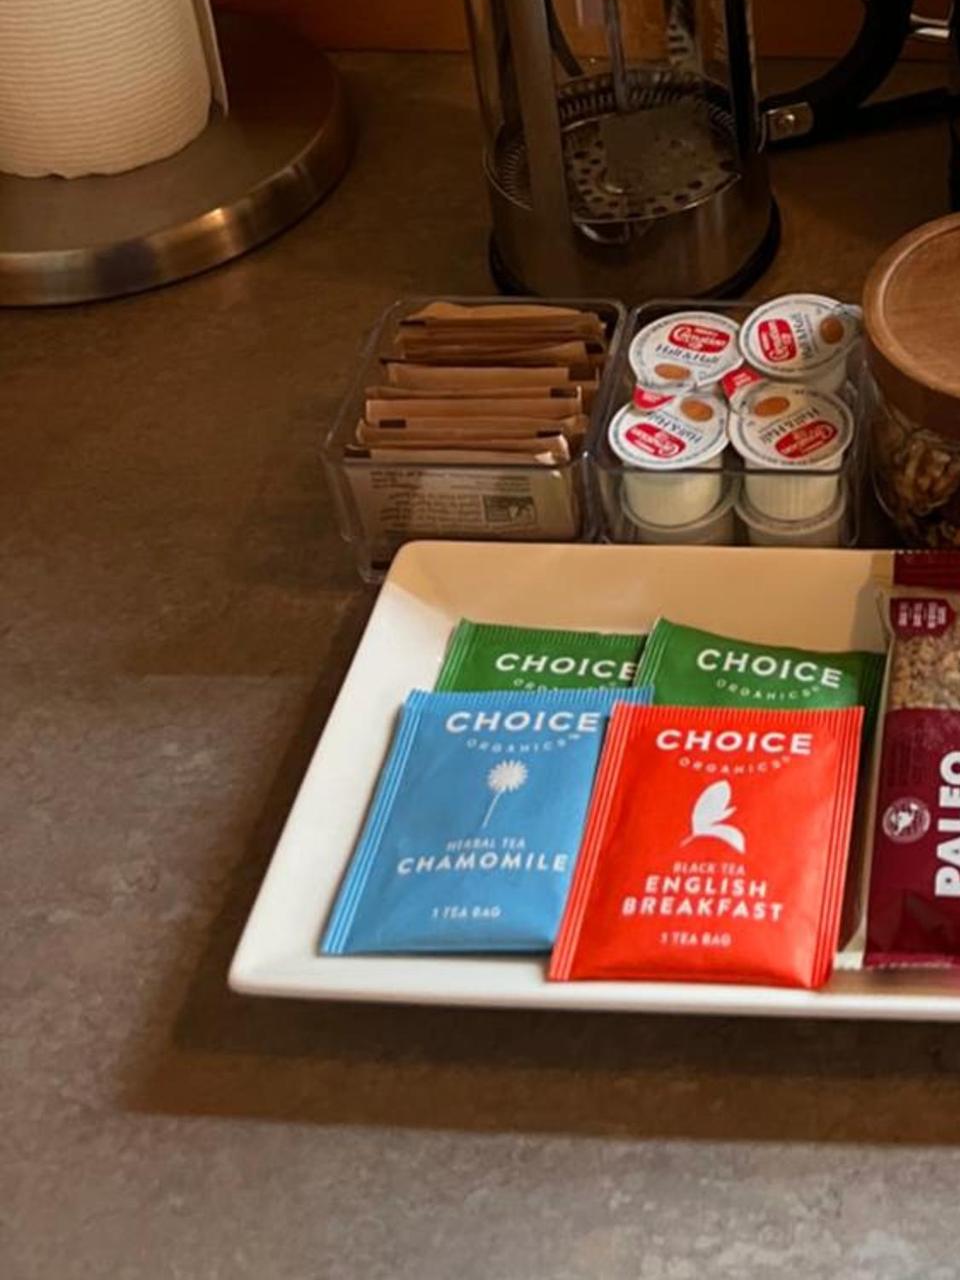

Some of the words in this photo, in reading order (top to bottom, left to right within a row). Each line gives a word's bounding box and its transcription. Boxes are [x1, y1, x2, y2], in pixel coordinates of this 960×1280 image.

[495, 652, 638, 681] CHOICE
[696, 648, 843, 689] CHOICE
[716, 677, 812, 701] ORGANICS
[445, 711, 601, 733] CHOICE
[466, 737, 567, 754] ORGANICS
[655, 728, 813, 756] CHOICE
[678, 755, 781, 775] ORGANICS
[446, 836, 496, 851] HERBAL
[502, 837, 526, 850] TEA
[396, 851, 569, 875] CHAMOMILE
[673, 861, 716, 875] BLACK
[721, 862, 746, 876] TEA
[644, 874, 768, 899] ENGLISH
[443, 906, 467, 918] TEA
[472, 906, 502, 918] BAG
[621, 895, 784, 922] BREAKFAST
[672, 931, 698, 945] TEA
[702, 931, 732, 947] BAG
